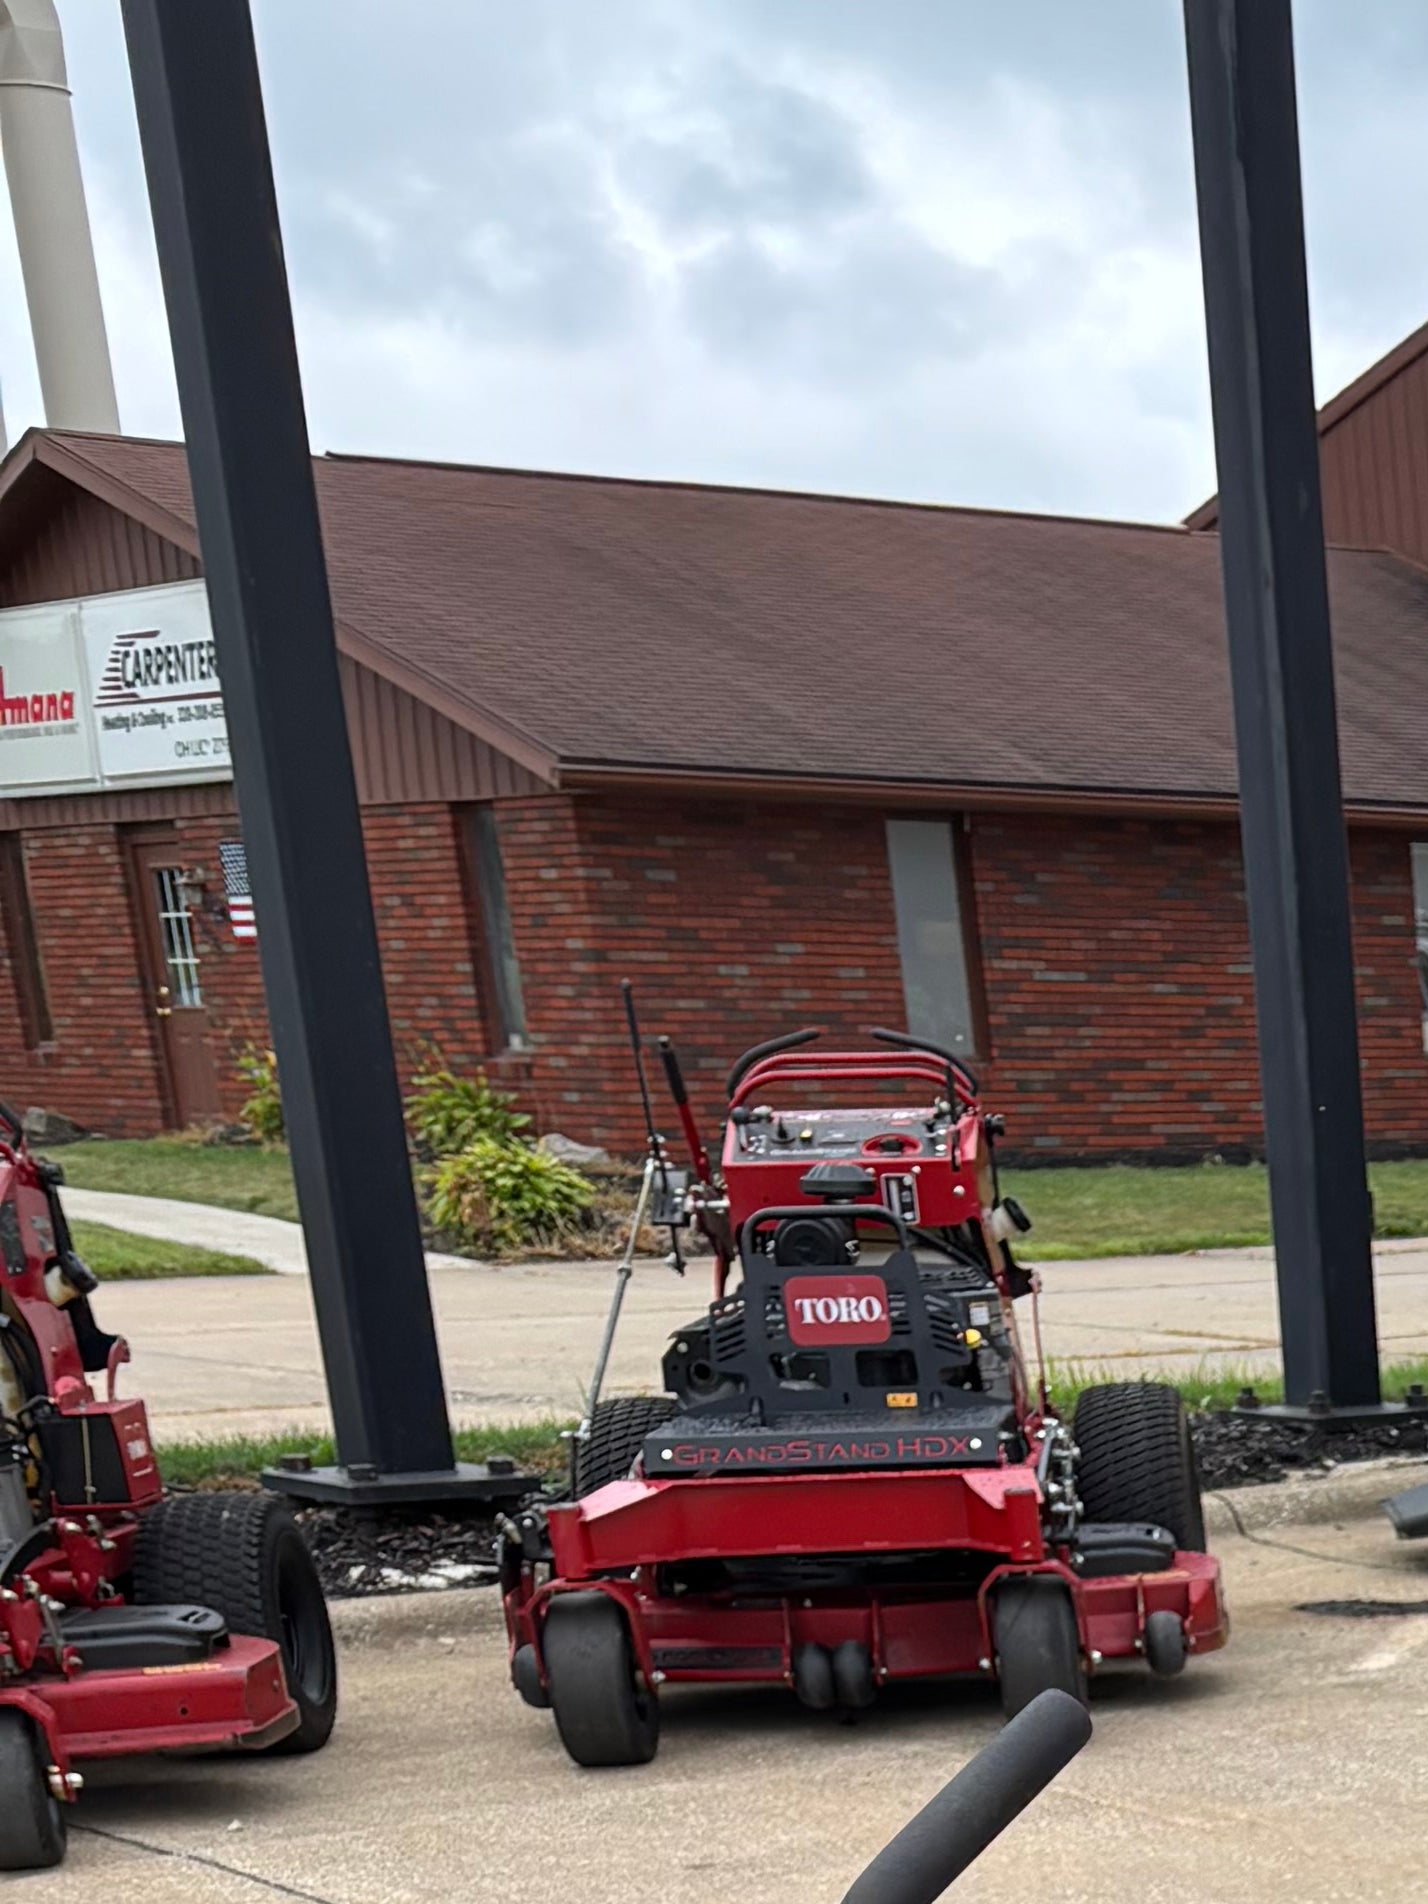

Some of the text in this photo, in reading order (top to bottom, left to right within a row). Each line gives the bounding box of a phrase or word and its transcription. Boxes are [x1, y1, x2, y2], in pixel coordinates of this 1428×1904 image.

[121, 640, 218, 688] CARPENTER
[0, 670, 75, 726] mana
[795, 1296, 882, 1324] TORO
[897, 1436, 970, 1459] HDX
